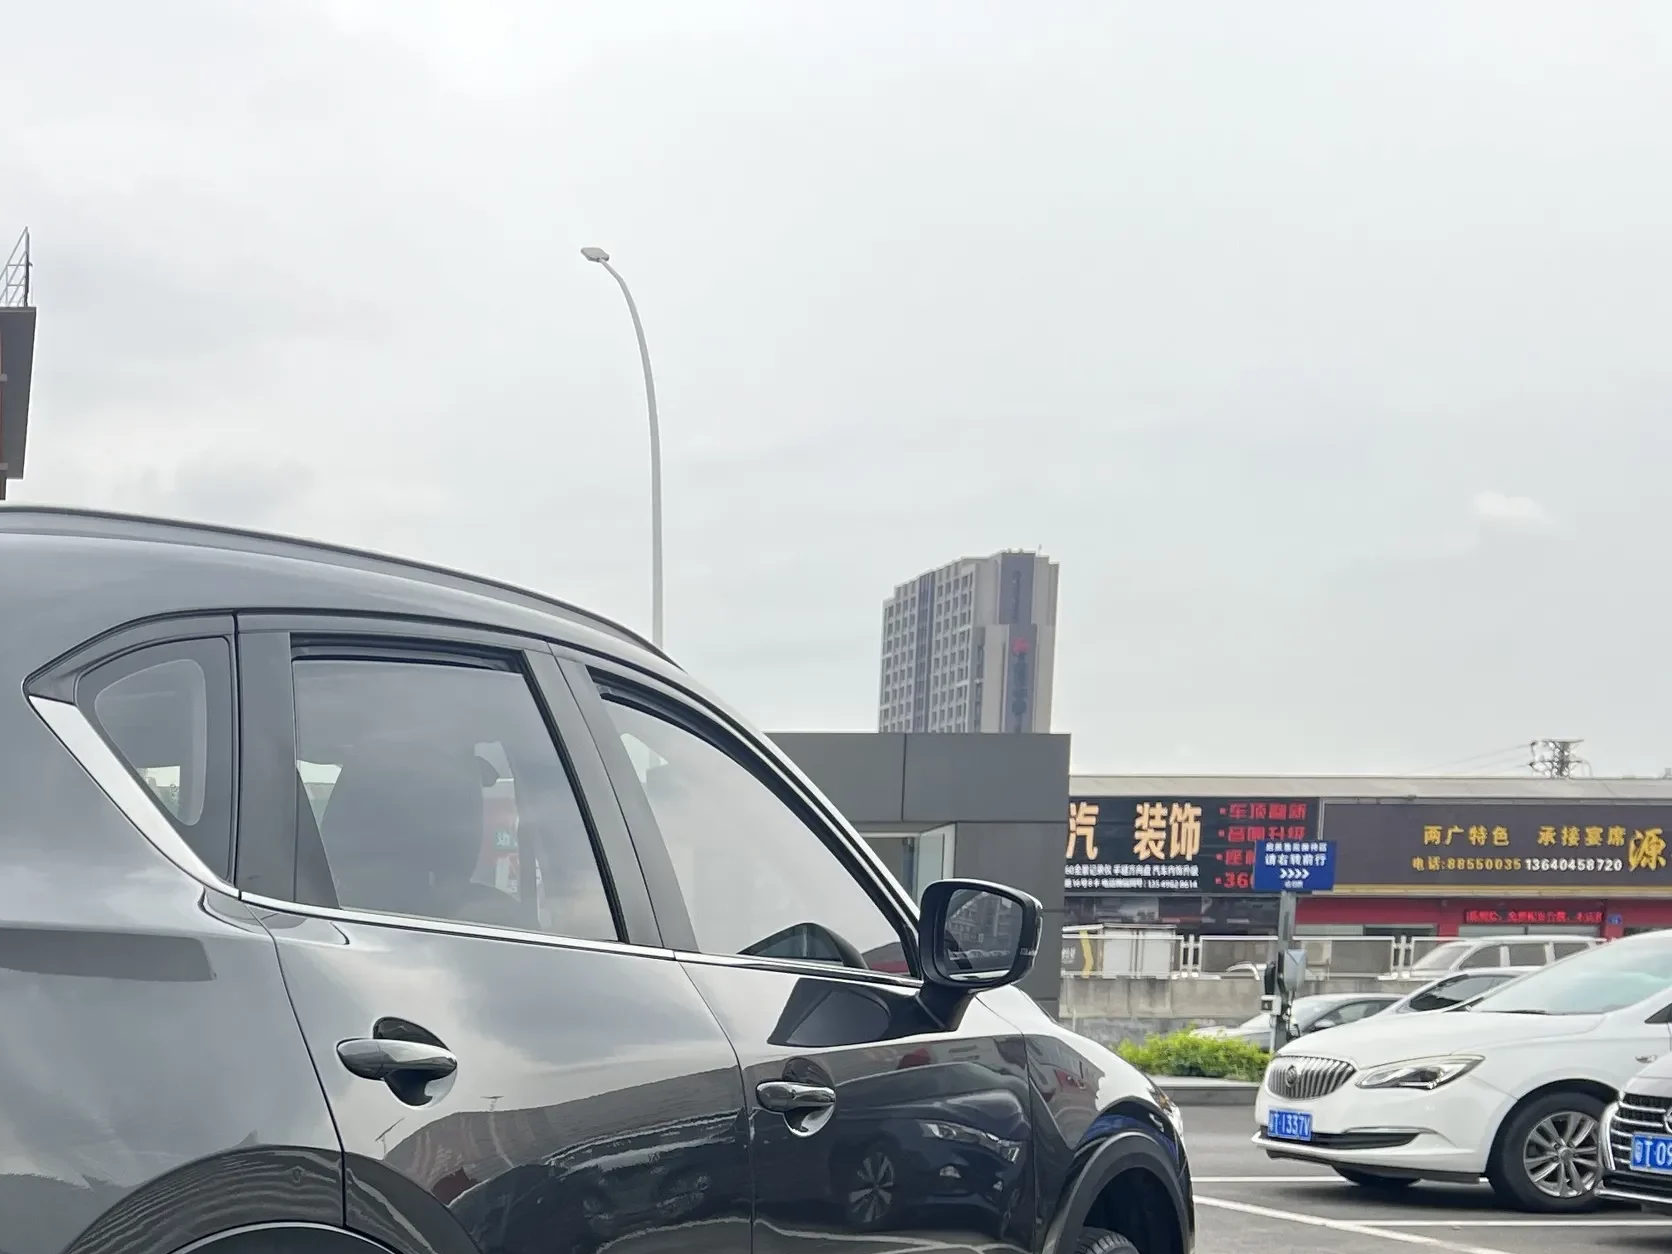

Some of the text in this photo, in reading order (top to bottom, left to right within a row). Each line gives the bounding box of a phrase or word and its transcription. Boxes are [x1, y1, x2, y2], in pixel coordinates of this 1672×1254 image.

[1133, 802, 1202, 861] 装饰
[1423, 825, 1626, 847] 两广特色 承接宴席
[1525, 858, 1623, 872] 13640458720
[1223, 871, 1254, 888] 36
